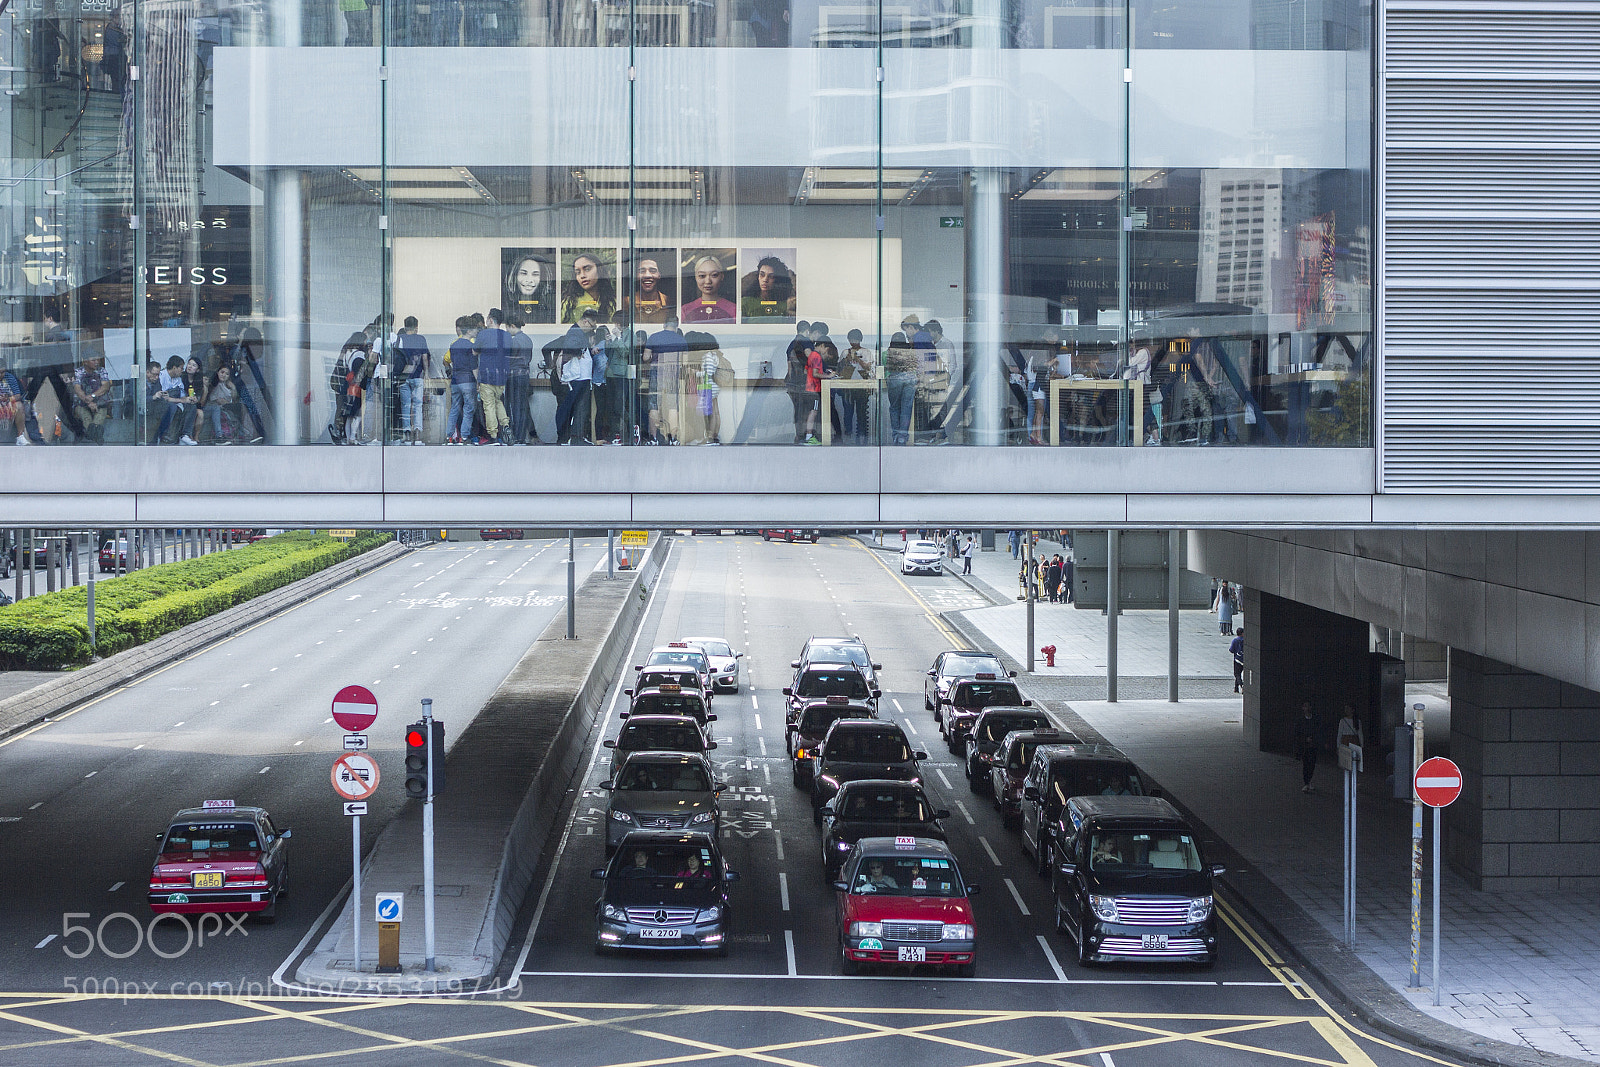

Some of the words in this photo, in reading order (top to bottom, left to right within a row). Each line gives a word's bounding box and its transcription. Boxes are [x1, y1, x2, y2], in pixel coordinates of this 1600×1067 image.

[138, 265, 228, 285] REISS
[1114, 280, 1169, 290] BTHERS
[203, 873, 214, 881] TB
[197, 879, 220, 887] 4850
[642, 929, 653, 937] KK
[656, 929, 679, 937] 2707
[905, 946, 917, 954] MX
[901, 953, 923, 961] 3431
